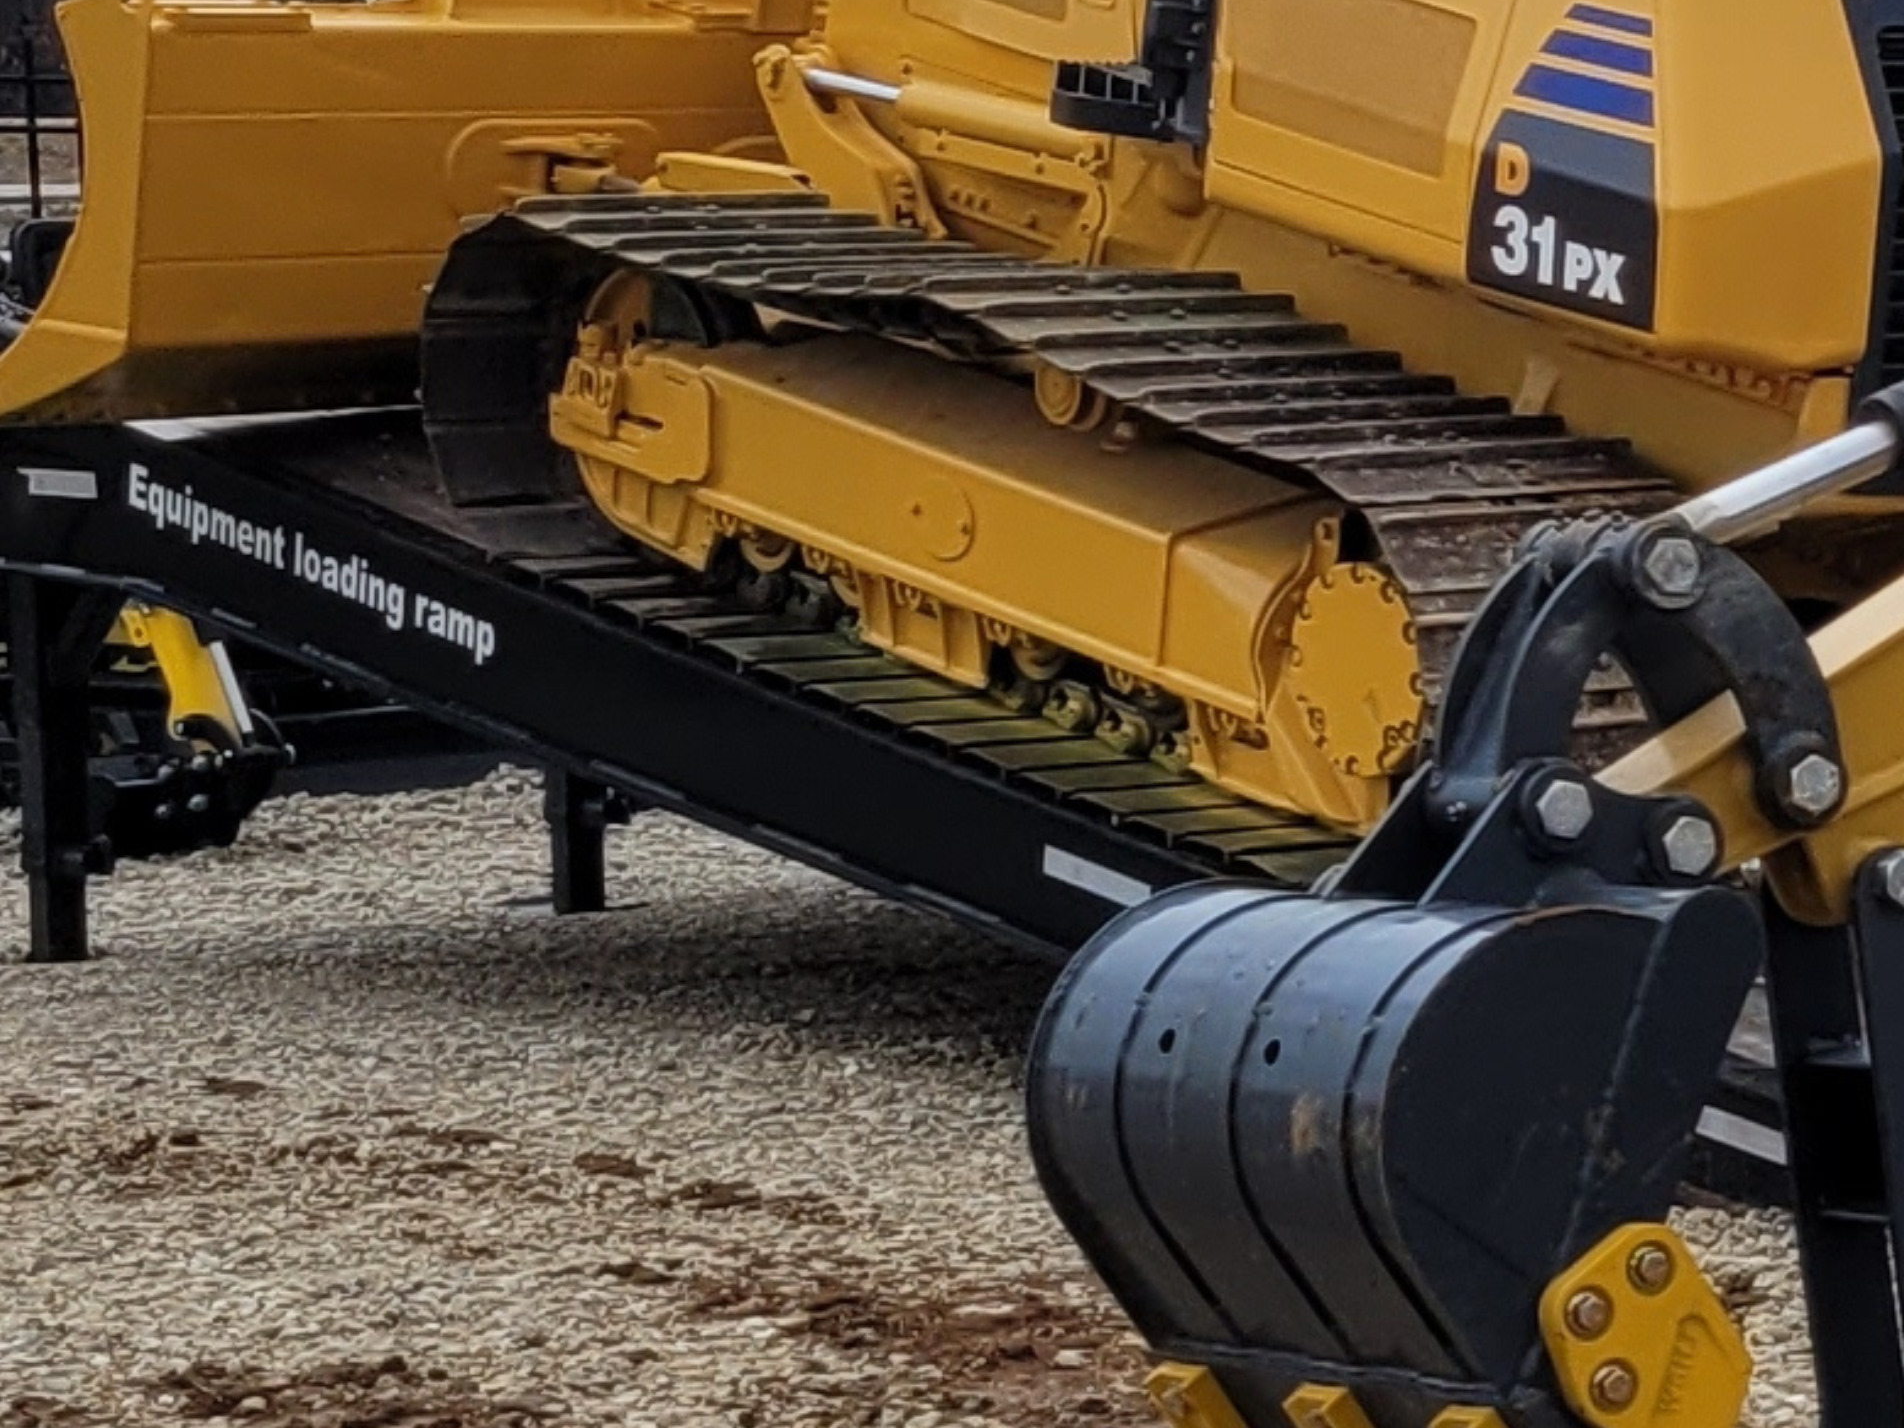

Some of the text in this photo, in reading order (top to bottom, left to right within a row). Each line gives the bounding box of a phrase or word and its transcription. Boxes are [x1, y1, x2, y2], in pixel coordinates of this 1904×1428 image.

[1494, 139, 1531, 196] D
[127, 462, 496, 665] Equipment loading ramp
